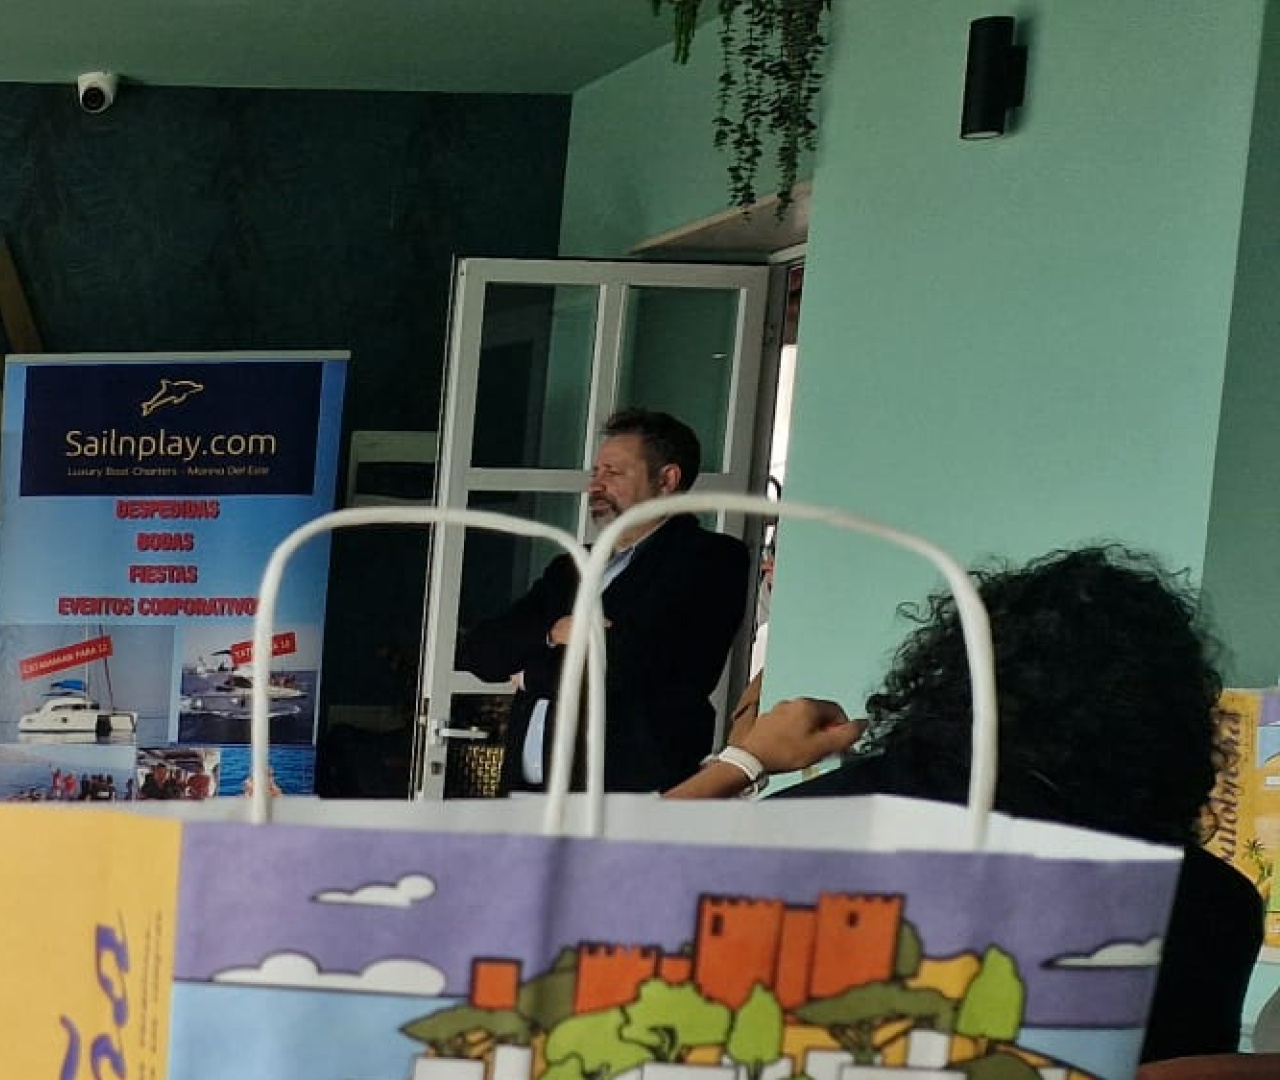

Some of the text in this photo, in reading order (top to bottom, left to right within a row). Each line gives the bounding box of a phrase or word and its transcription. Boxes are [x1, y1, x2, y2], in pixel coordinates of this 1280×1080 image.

[65, 428, 277, 461] Sailnplay.com
[116, 500, 220, 519] DESPEDIDAS
[137, 532, 194, 551] BODAS
[129, 565, 197, 584] FIESTAS
[58, 597, 134, 616] EVENTOS
